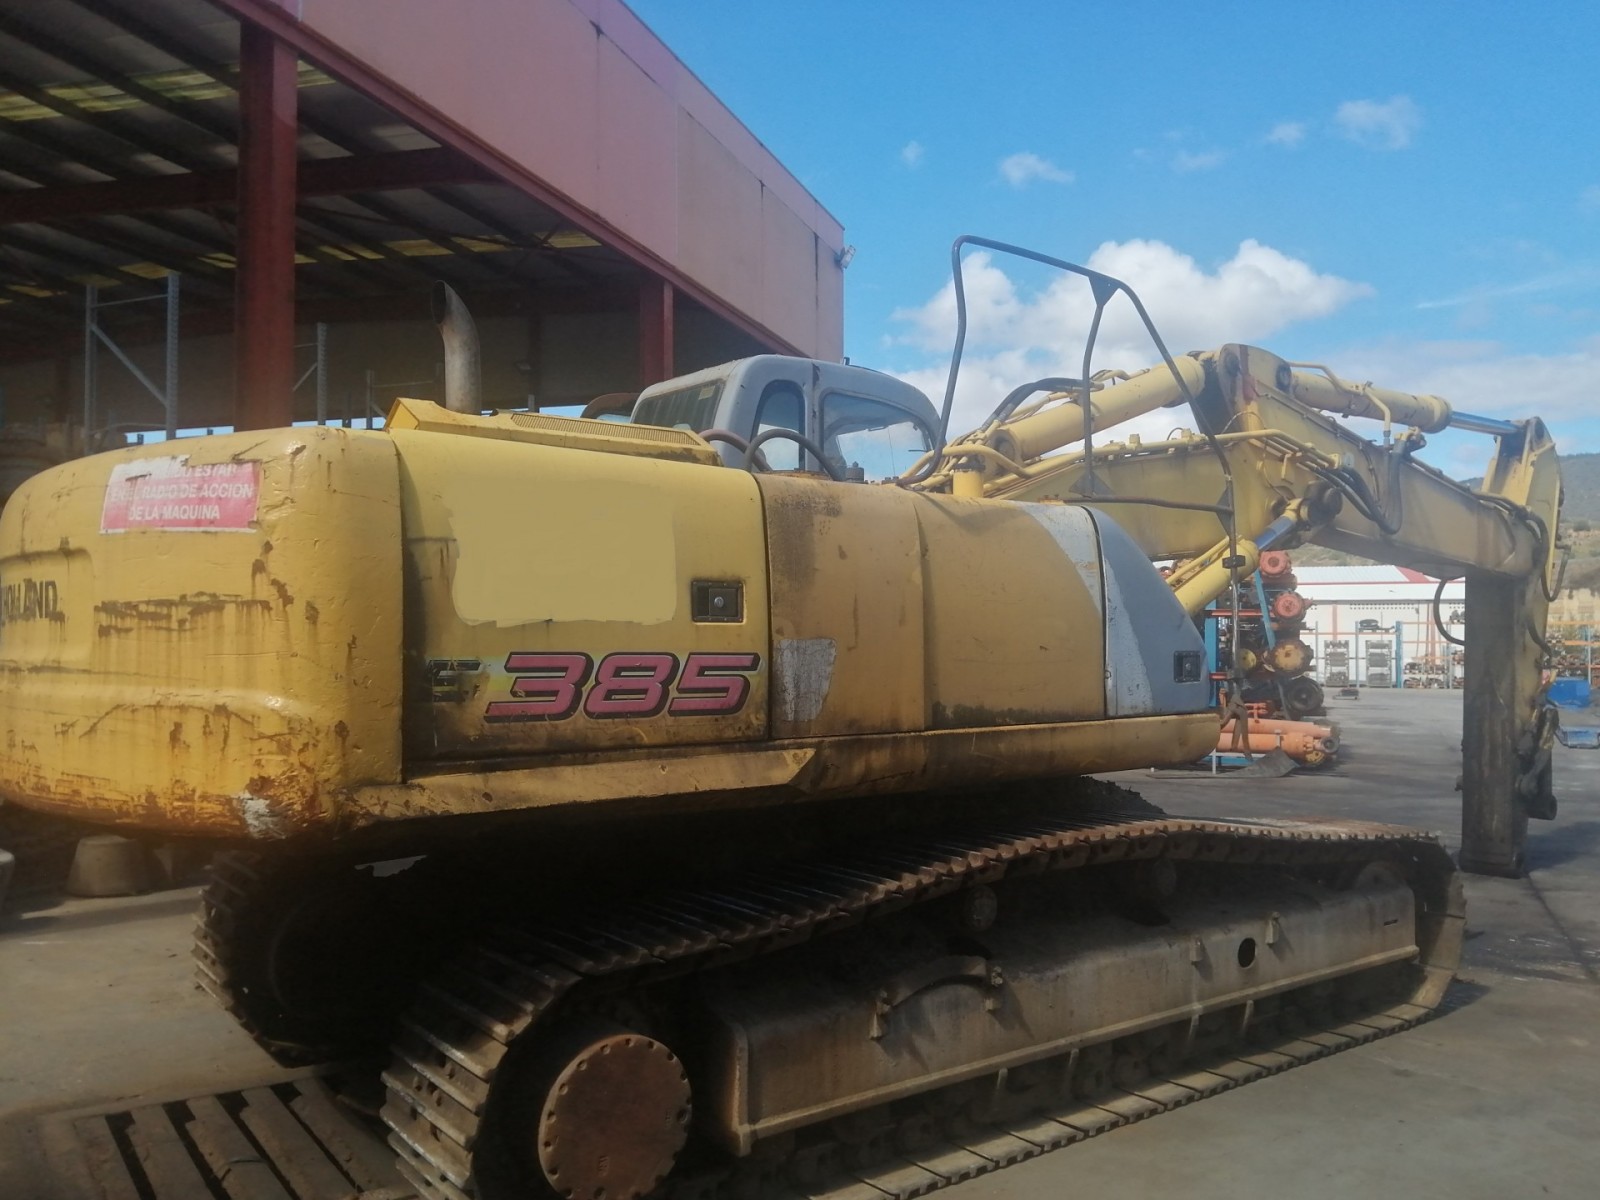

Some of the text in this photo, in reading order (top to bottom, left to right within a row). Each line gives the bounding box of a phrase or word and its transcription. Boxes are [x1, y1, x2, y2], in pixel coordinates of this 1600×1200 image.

[142, 484, 177, 499] RADIO
[179, 484, 198, 498] DE
[128, 504, 221, 521] DE LA MAQUINA
